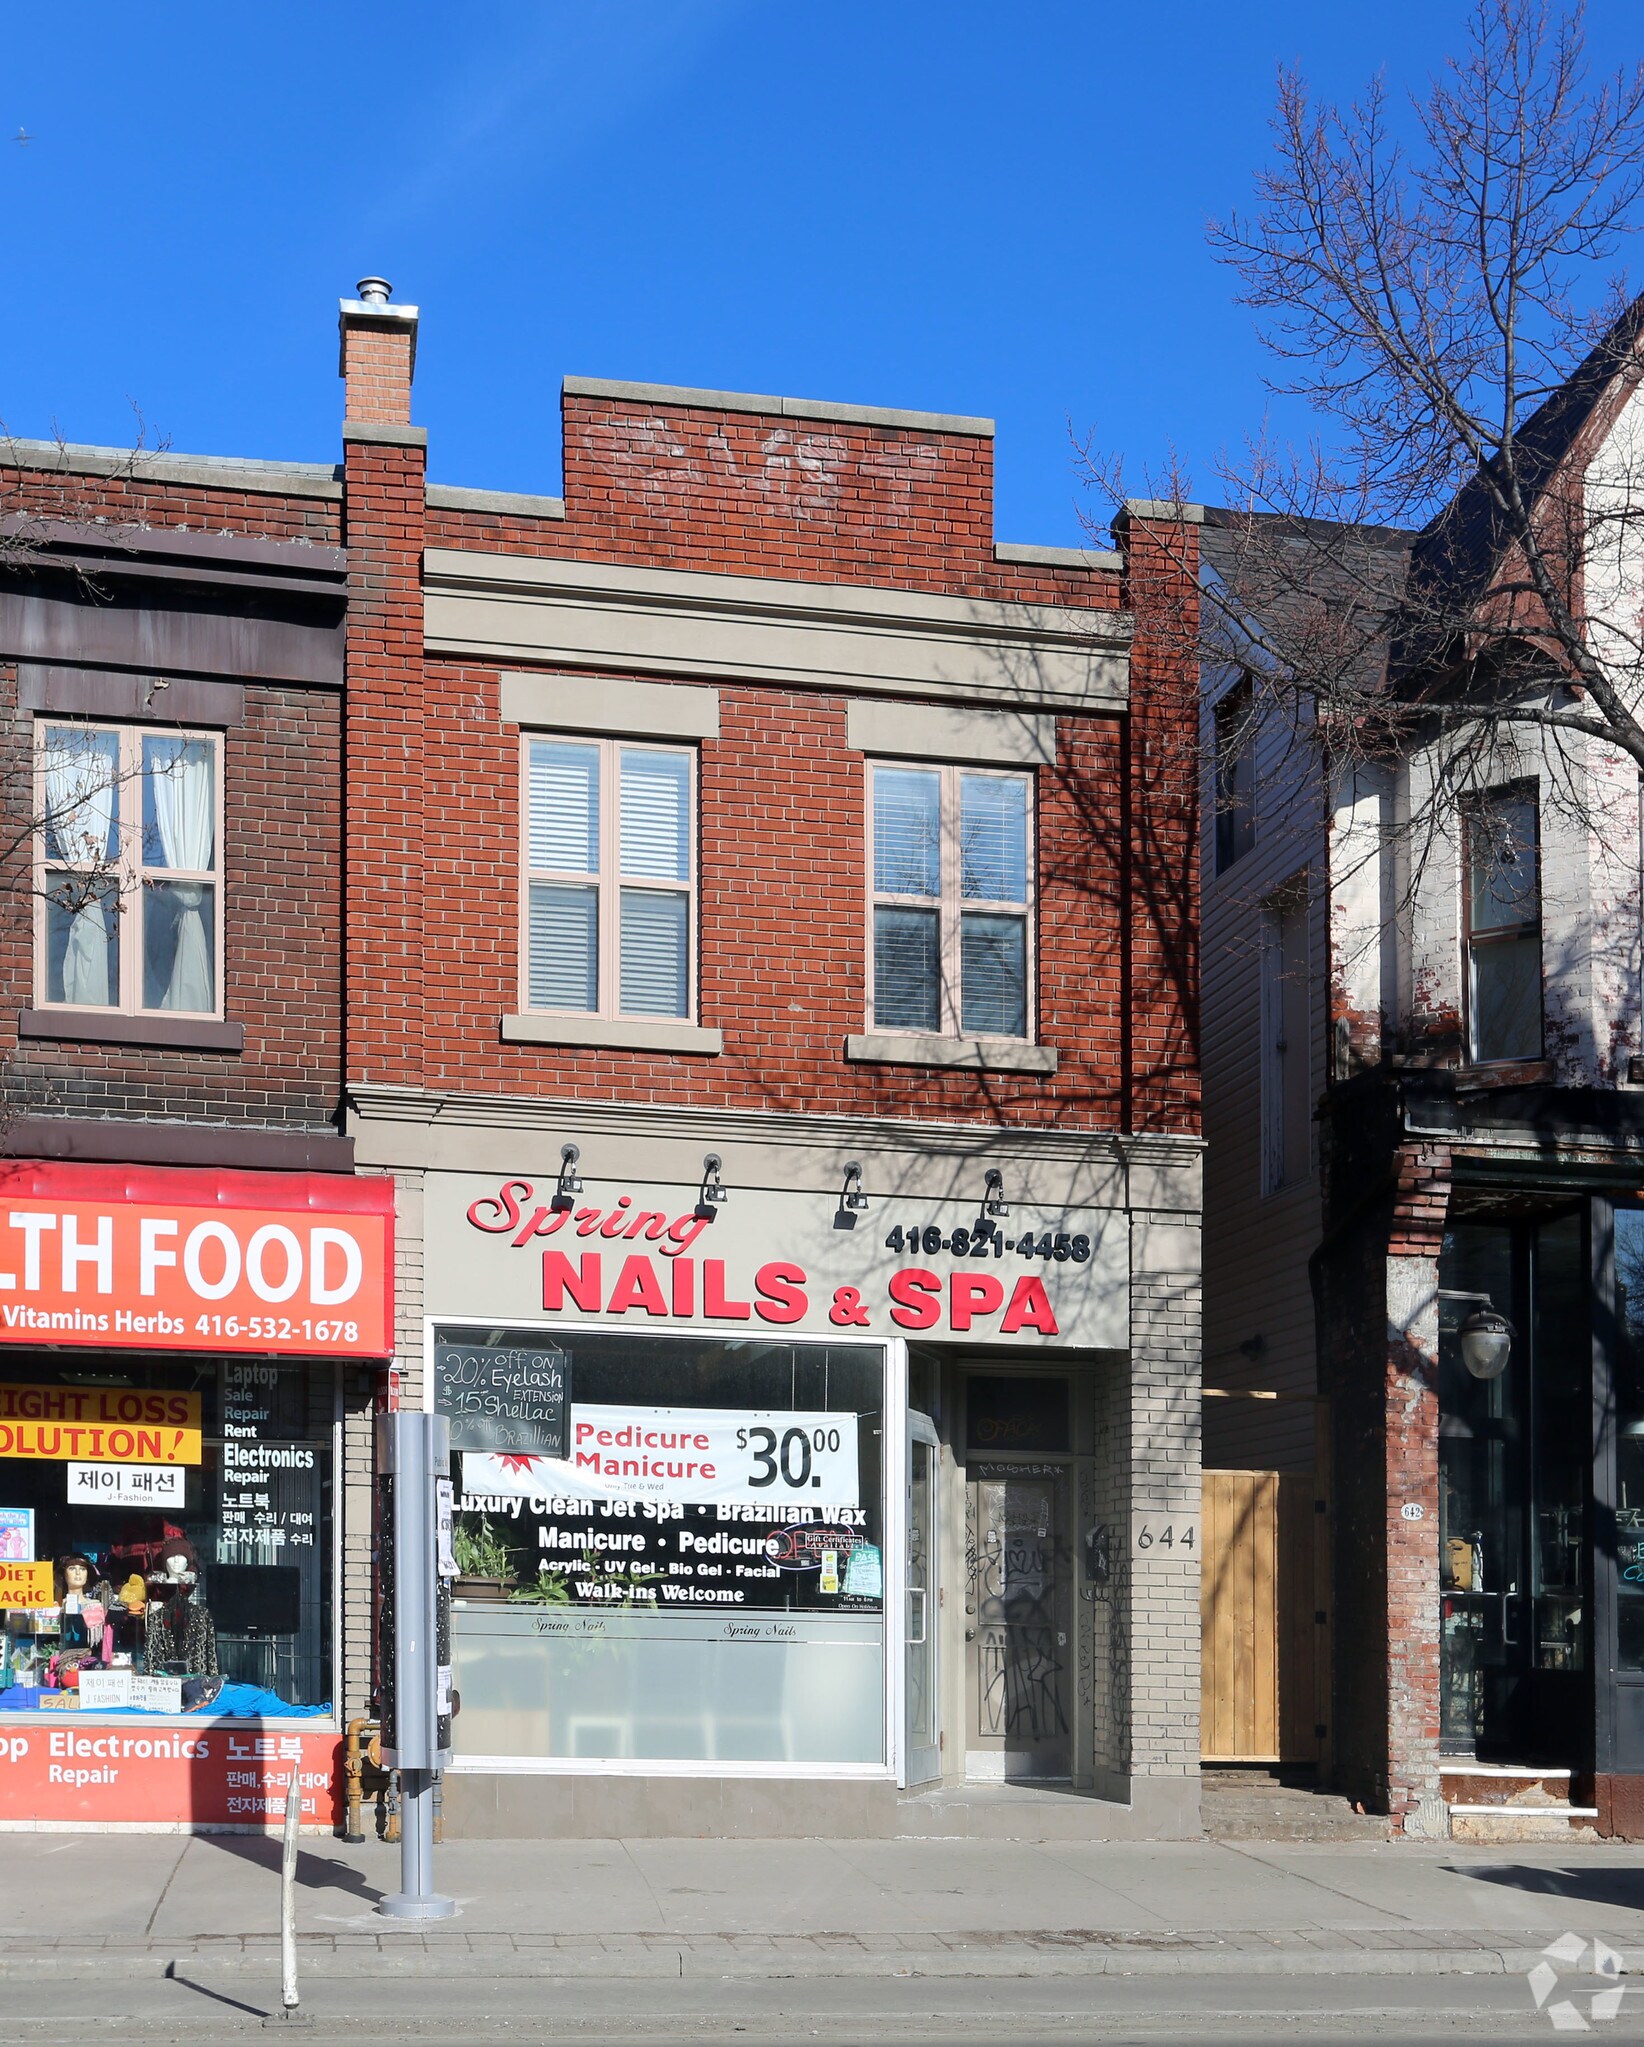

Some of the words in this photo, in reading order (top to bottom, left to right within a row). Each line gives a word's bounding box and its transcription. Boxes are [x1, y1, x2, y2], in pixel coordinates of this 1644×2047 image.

[467, 1180, 711, 1256] Spring
[885, 1225, 1091, 1263] 416-821-4458
[140, 1218, 363, 1305] FOOD
[542, 1250, 809, 1324] NAILS
[829, 1286, 871, 1327] &
[888, 1268, 1060, 1336] SPA
[2, 1304, 109, 1331] Vitamins
[115, 1310, 185, 1335] Herbs
[195, 1314, 359, 1342] 416-532-1678
[223, 1360, 278, 1390] Laptop
[443, 1353, 491, 1388] 20%
[531, 1356, 555, 1369] ON
[491, 1366, 563, 1393] Eyelash
[0, 1389, 89, 1421] IGHT
[100, 1394, 189, 1424] LOSS
[224, 1388, 254, 1402] Sale
[224, 1406, 270, 1422] Repair
[484, 1395, 557, 1422] Shellac
[224, 1424, 257, 1438] Rent
[575, 1423, 710, 1451] Pedicure
[223, 1442, 314, 1469] Electronics
[575, 1452, 717, 1480] Manicure
[78, 1470, 122, 1491] 제이
[131, 1472, 175, 1493] 패션
[224, 1469, 270, 1486] Repair
[647, 1482, 665, 1491] Wed
[222, 1492, 270, 1510] 노트북
[450, 1490, 523, 1519] Luxury
[529, 1493, 594, 1516] Clean
[600, 1498, 639, 1518] Jet
[642, 1500, 684, 1524] Spa
[716, 1503, 814, 1524] Brazilian
[822, 1504, 867, 1526] Wax
[1404, 1506, 1420, 1518] 642
[222, 1511, 246, 1524] 판매
[254, 1512, 277, 1525] 수리
[290, 1512, 313, 1526] 대여
[222, 1527, 287, 1547] 전자제품
[290, 1532, 313, 1546] 수리
[538, 1526, 646, 1551] Manicure
[679, 1531, 780, 1556] Pedicure
[1138, 1524, 1196, 1550] 644
[538, 1558, 591, 1574] Acrylic
[604, 1561, 626, 1572] UV
[629, 1562, 655, 1574] Gel
[669, 1563, 693, 1575] Bio
[696, 1564, 722, 1576] Gel
[735, 1565, 781, 1578] Facial
[575, 1582, 657, 1600] Walk-ins
[661, 1584, 744, 1602] Welcome
[531, 1618, 570, 1632] Spring
[575, 1620, 606, 1632] Nails
[723, 1622, 761, 1638] Spring
[766, 1624, 797, 1636] Nails
[43, 1698, 80, 1709] SAL
[49, 1732, 209, 1759] Electronics
[226, 1736, 303, 1764] 노트북
[49, 1764, 118, 1787] Repair
